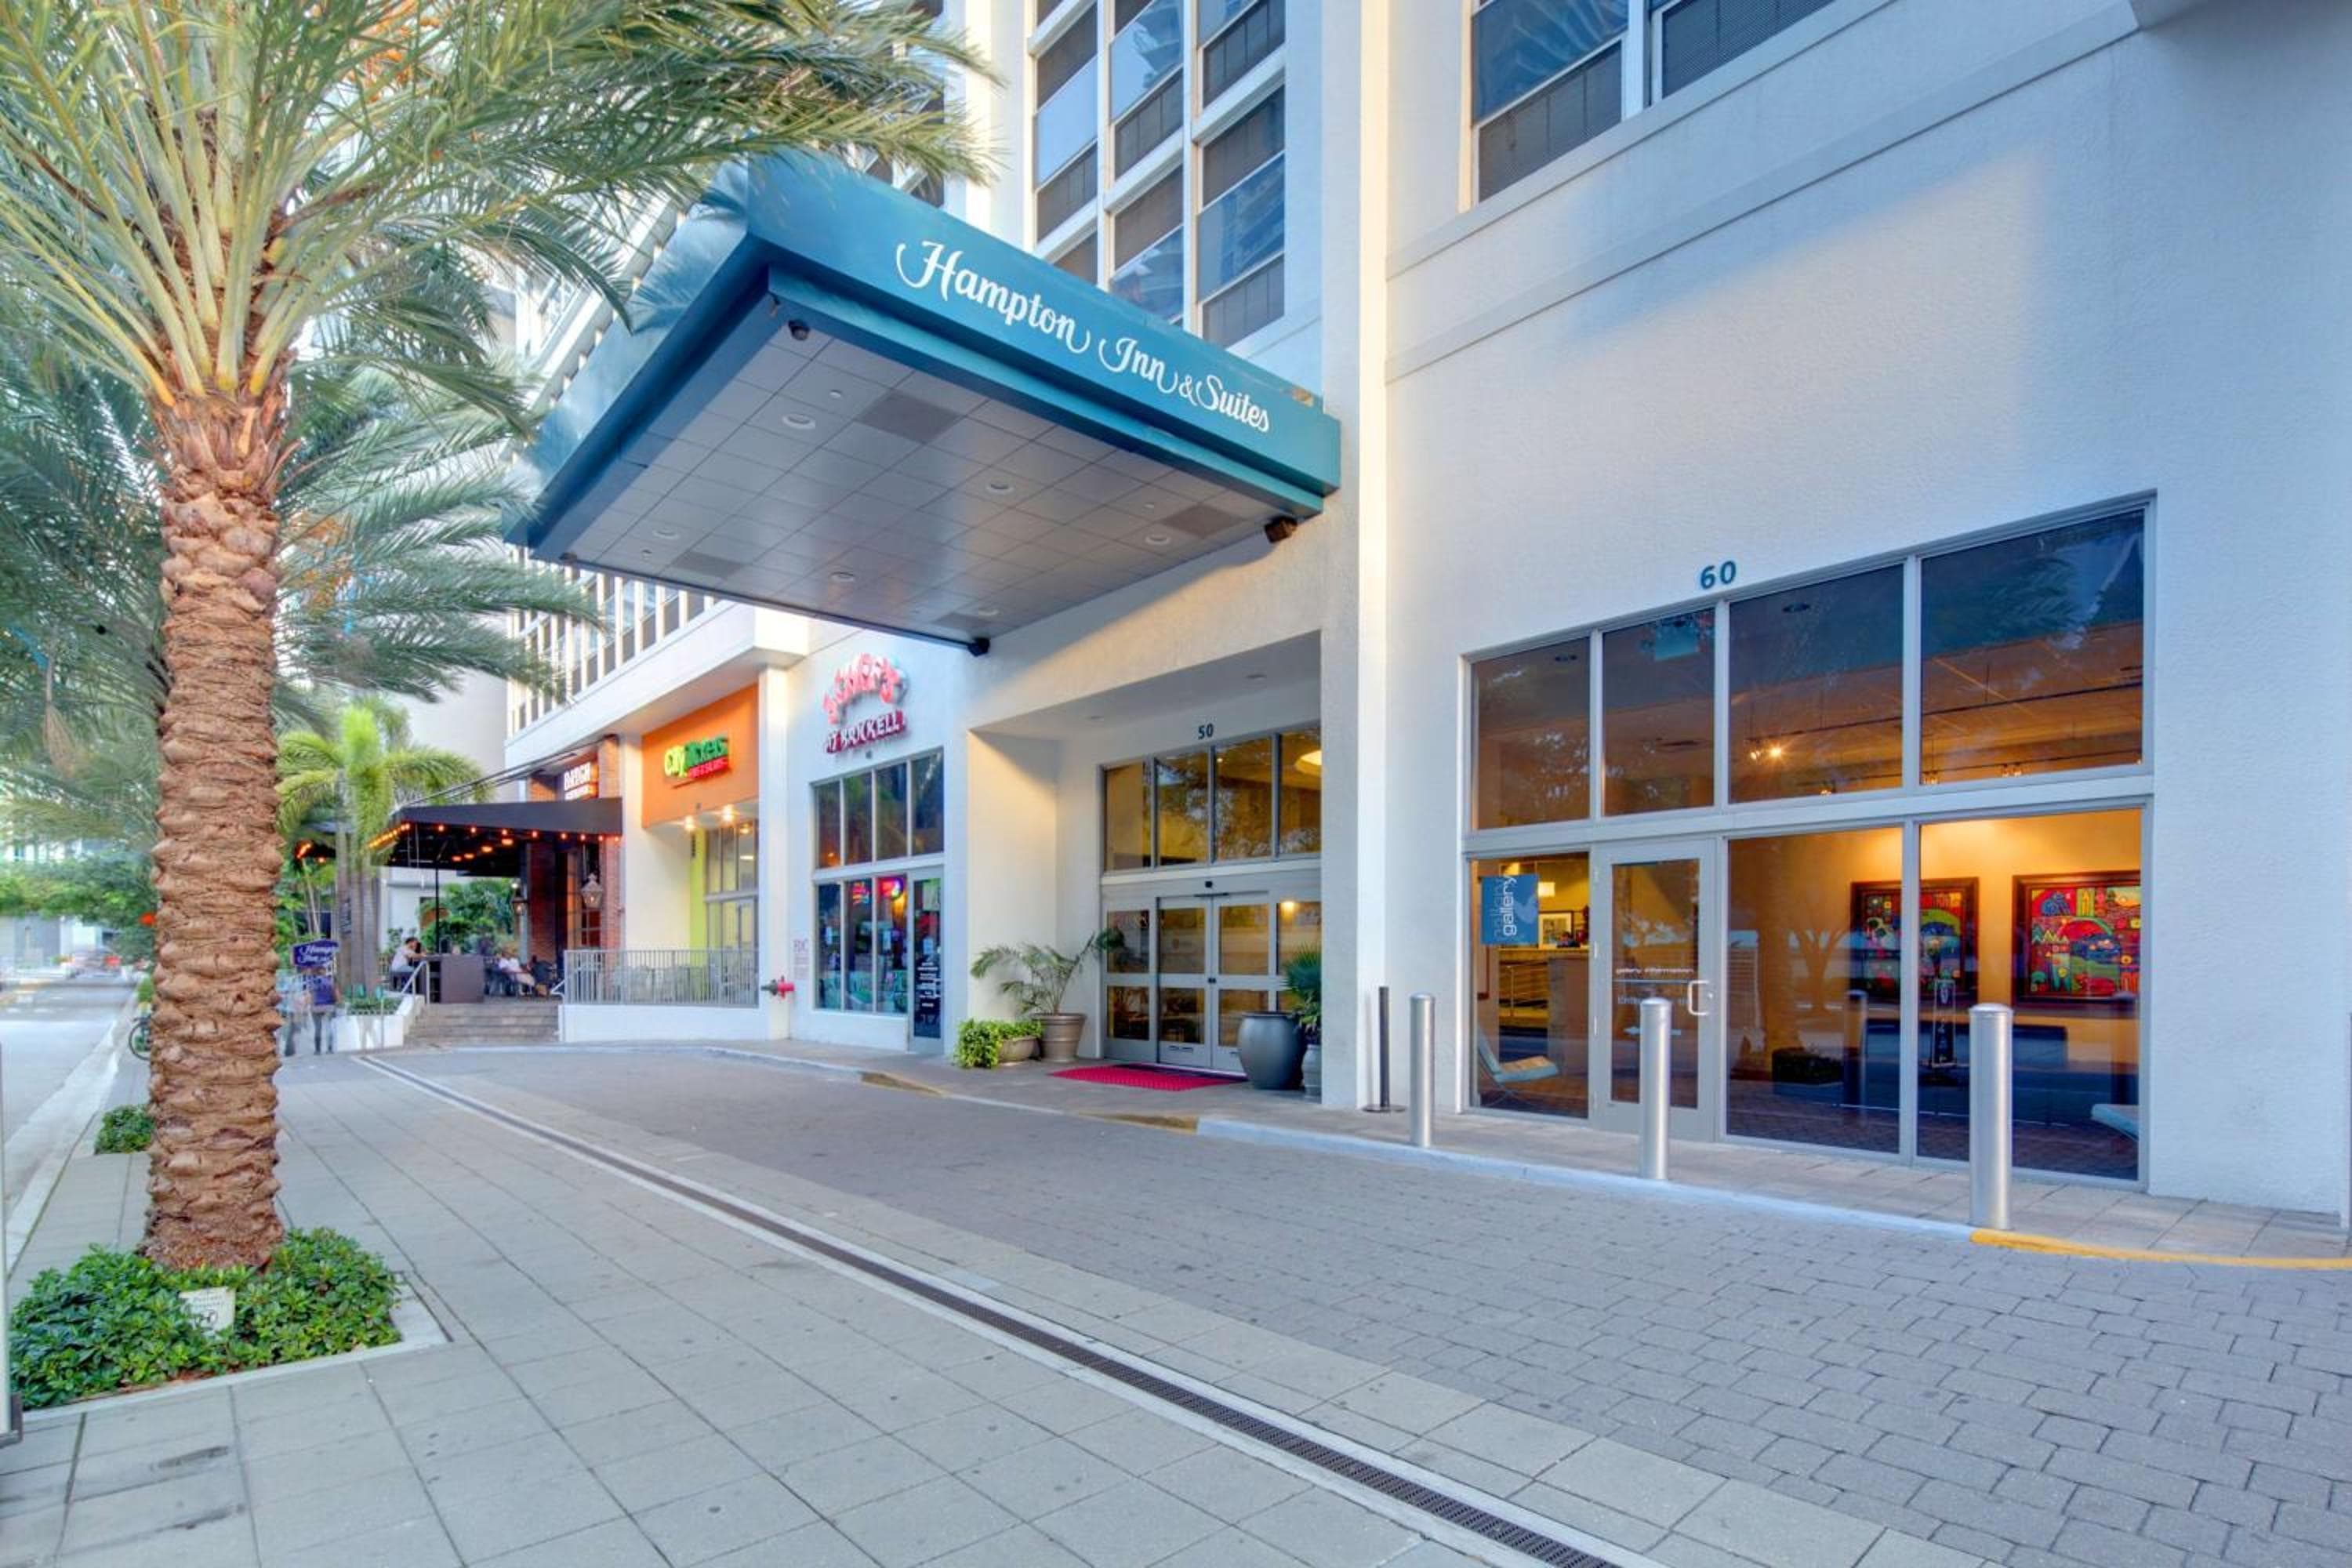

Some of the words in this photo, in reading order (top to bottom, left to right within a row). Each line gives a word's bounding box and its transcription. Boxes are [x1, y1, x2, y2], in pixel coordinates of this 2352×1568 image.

[895, 239, 1091, 354] Hampton
[1098, 337, 1178, 394] Inn
[1195, 373, 1270, 434] Suites
[1700, 560, 1737, 590] 60
[1198, 723, 1214, 740] 50
[1500, 875, 1517, 937] gallery
